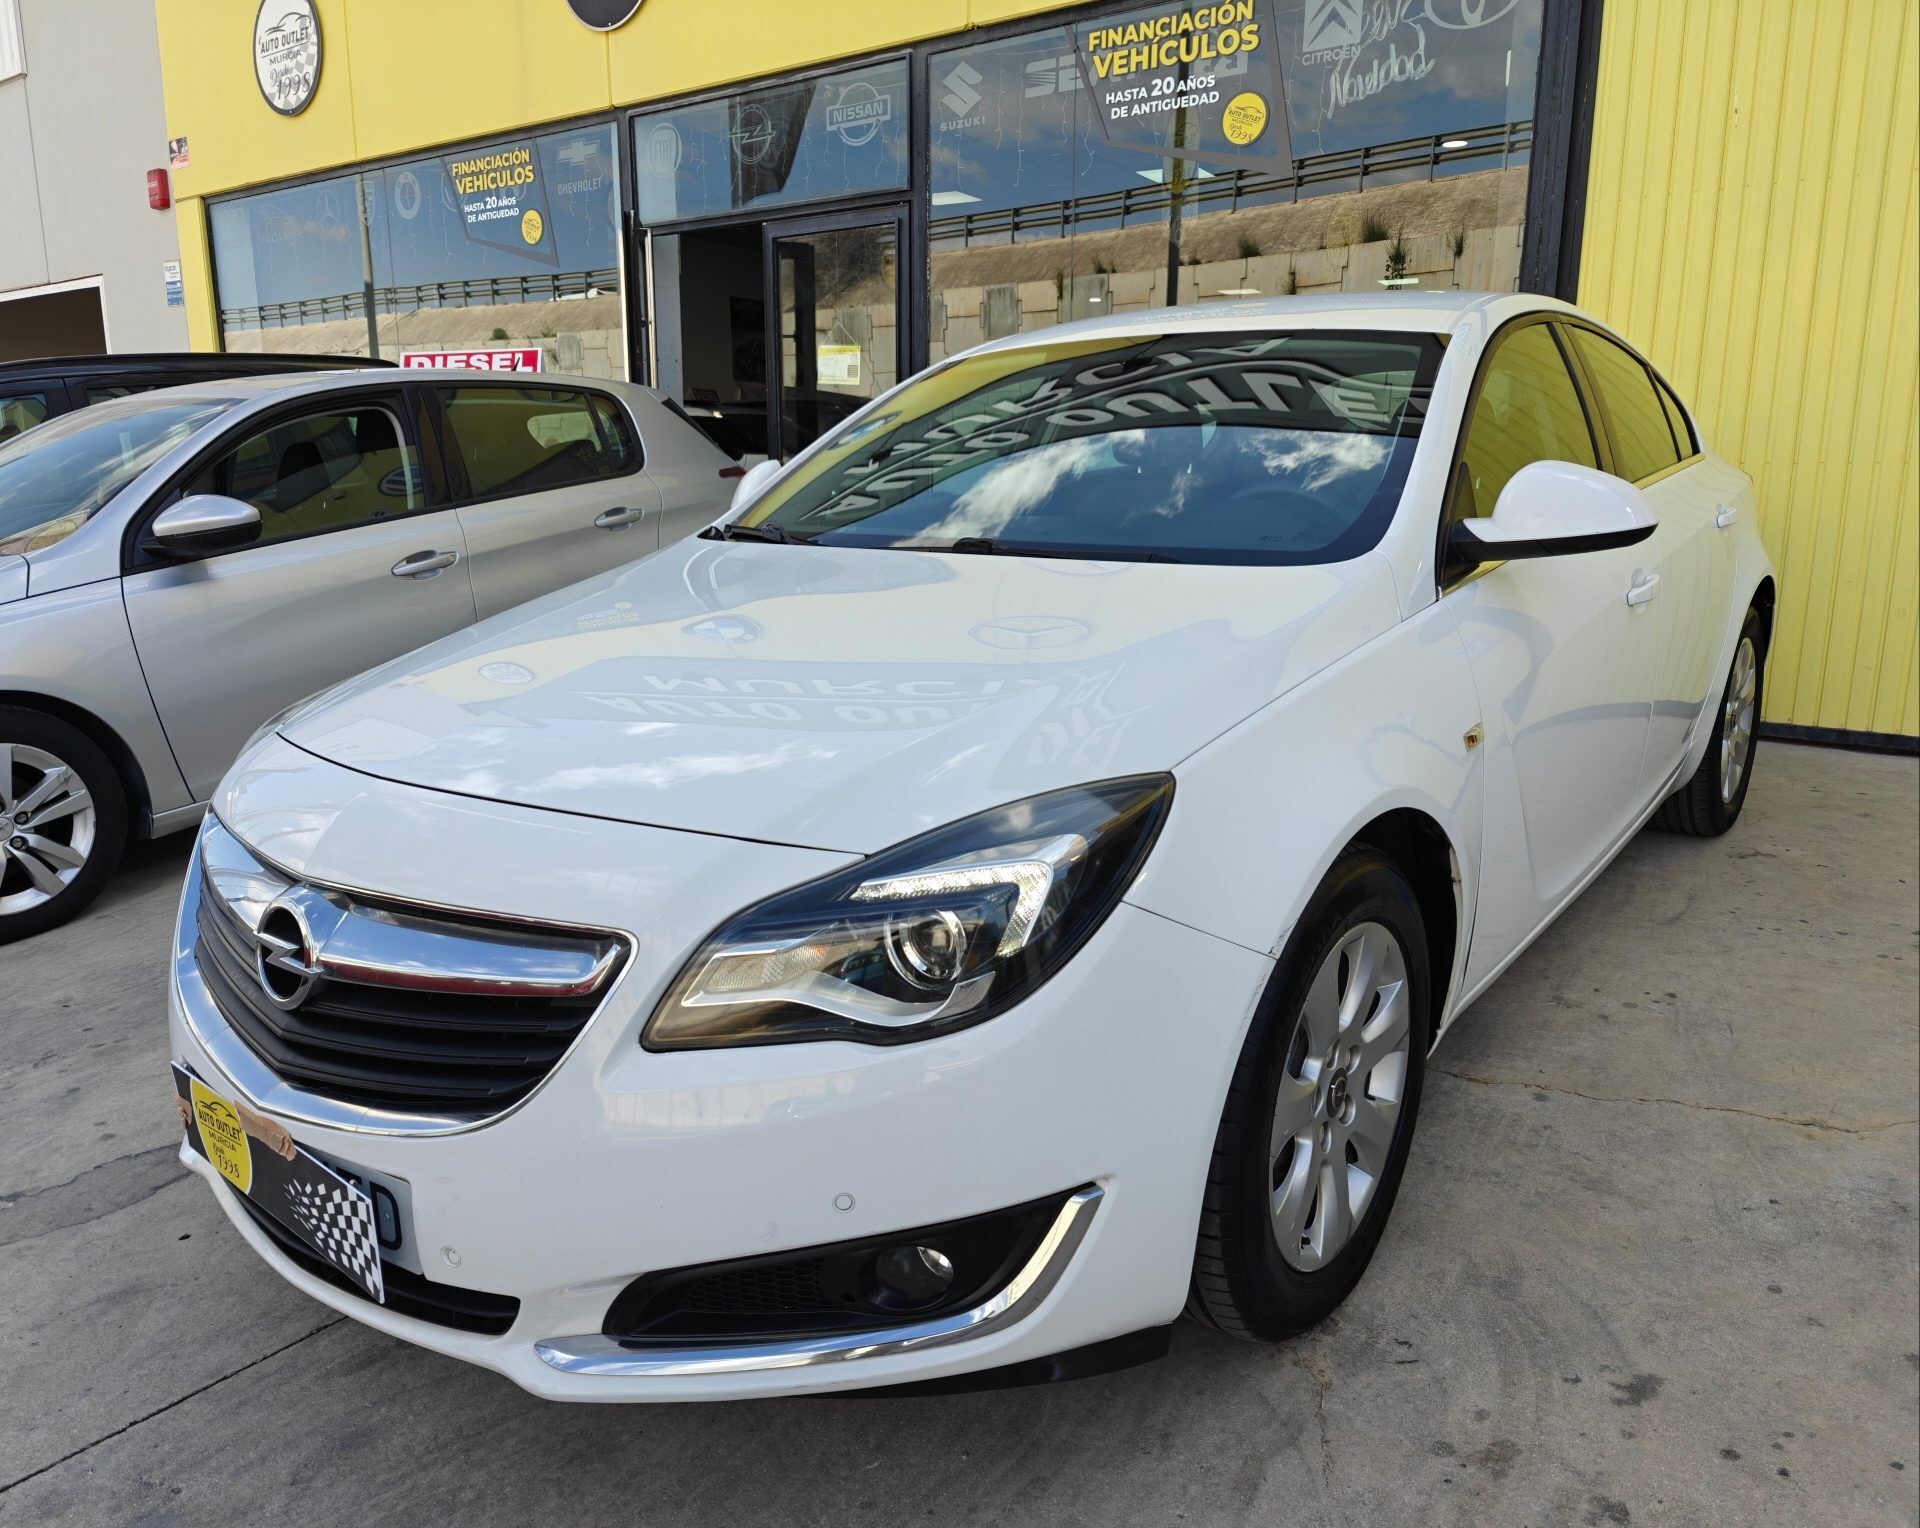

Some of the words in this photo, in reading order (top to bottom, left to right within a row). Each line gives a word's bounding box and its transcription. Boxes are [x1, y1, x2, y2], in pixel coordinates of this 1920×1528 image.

[260, 36, 279, 55] AUTO
[281, 26, 310, 47] OUTLET
[1088, 0, 1254, 52] FINANCIACIÓN
[269, 48, 302, 65] MURCIA
[1092, 23, 1261, 79] VEHÍCULOS
[277, 71, 311, 100] 1998
[1105, 87, 1148, 105] HASTA
[1150, 77, 1175, 97] 20
[1176, 75, 1216, 93] AÑOS
[833, 101, 883, 124] NISSAN
[1110, 107, 1129, 120] DE
[1131, 91, 1220, 117] ANTIGUEDAD
[940, 115, 985, 132] SUZUKI
[452, 147, 531, 177] FINANCIACIÓN
[455, 165, 535, 195] VEHÍCULOS
[464, 202, 485, 213] HASTA
[485, 196, 497, 210] 20
[498, 197, 517, 206] AÑOS
[467, 214, 477, 223] DE
[477, 208, 520, 222] ANTIGUEDAD
[409, 353, 533, 373] DIESEL
[198, 1108, 215, 1127] AUTO
[216, 1118, 241, 1141] OUTLET
[208, 1130, 237, 1152] MURCIA
[217, 1154, 240, 1179] 1998
